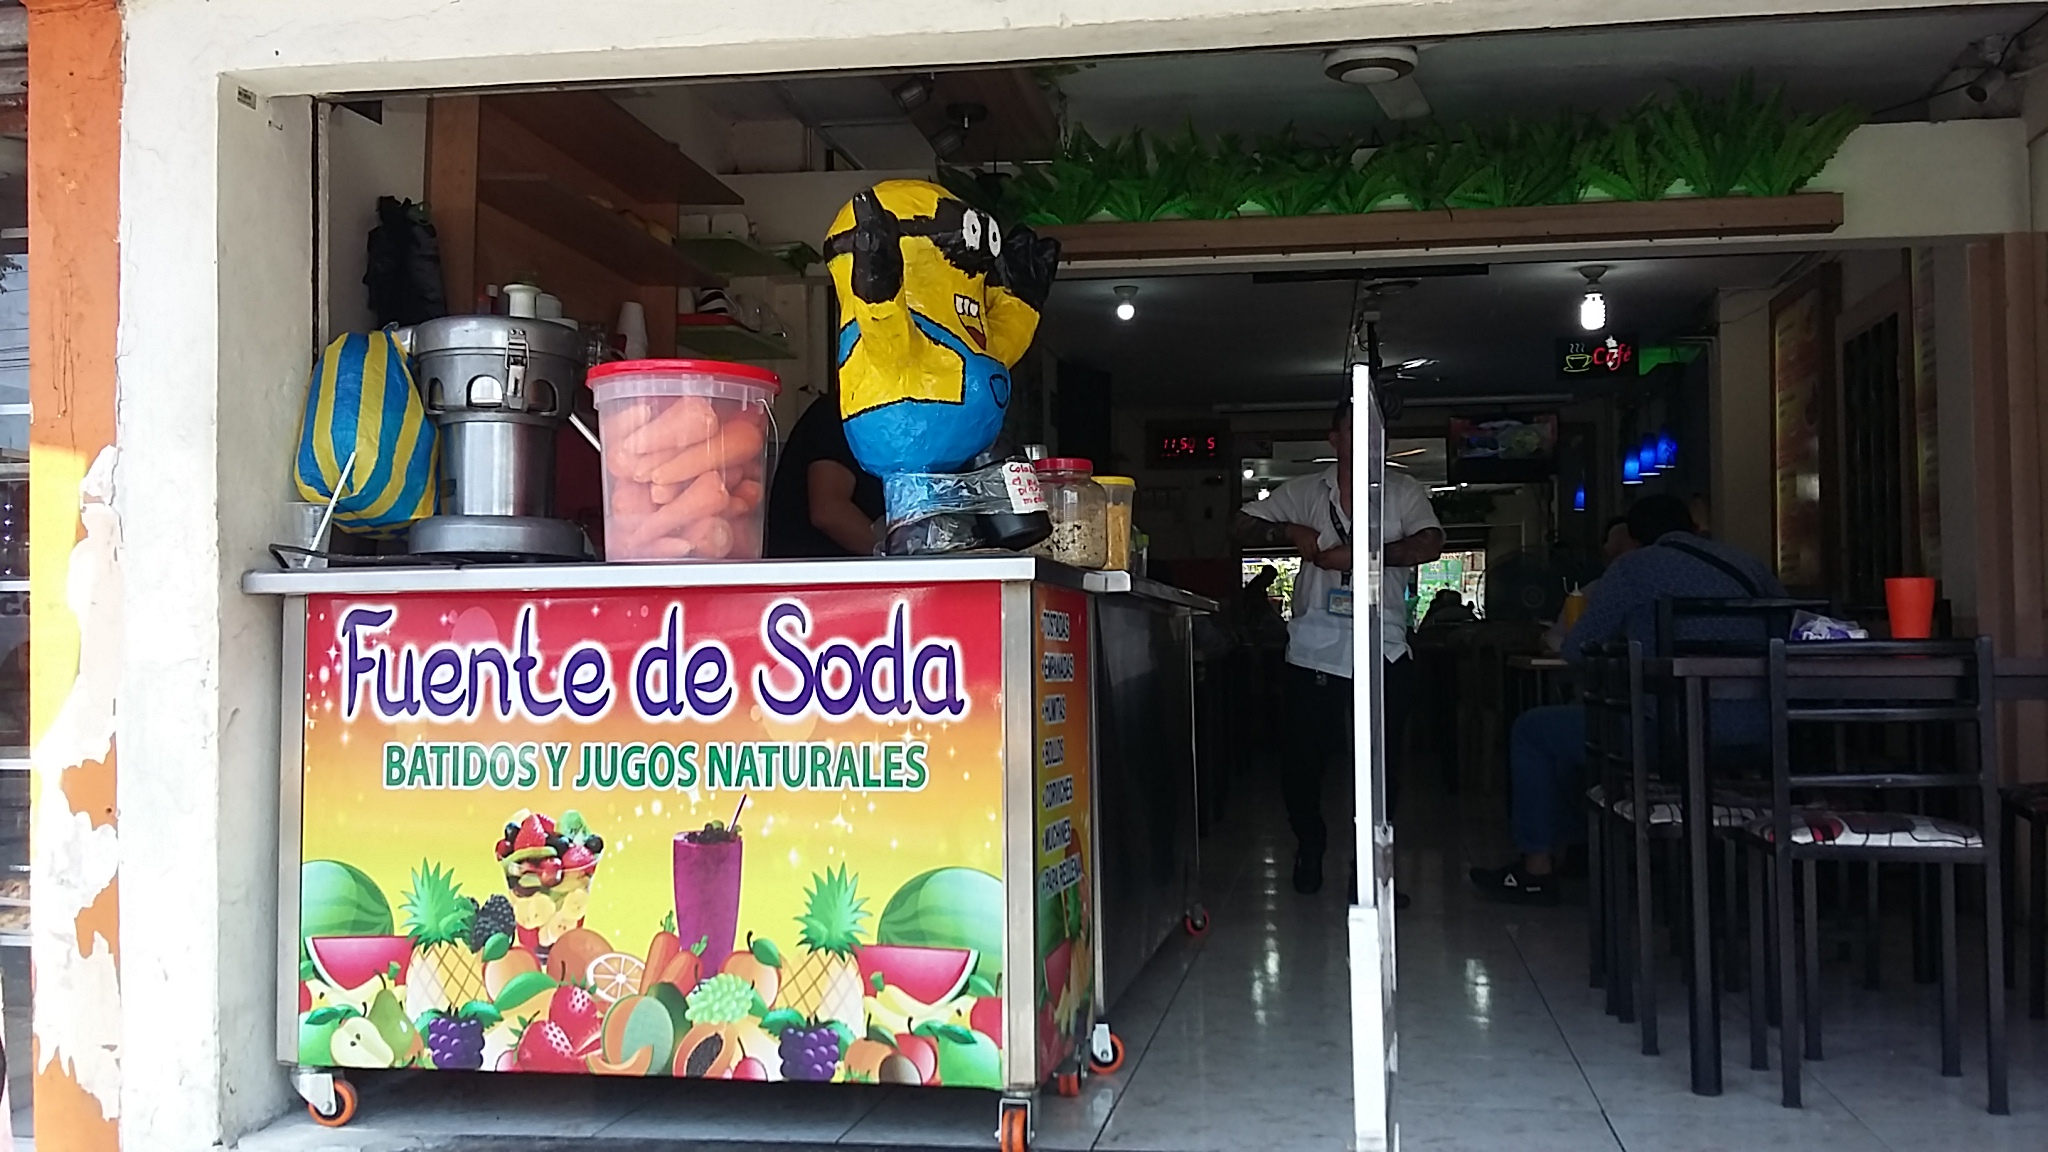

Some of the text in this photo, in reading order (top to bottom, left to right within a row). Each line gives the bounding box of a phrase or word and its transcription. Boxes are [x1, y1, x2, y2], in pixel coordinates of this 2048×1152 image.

[341, 603, 967, 717] Fuente de Soda
[385, 744, 927, 788] BATIDOS Y JUGOS NATURALES
